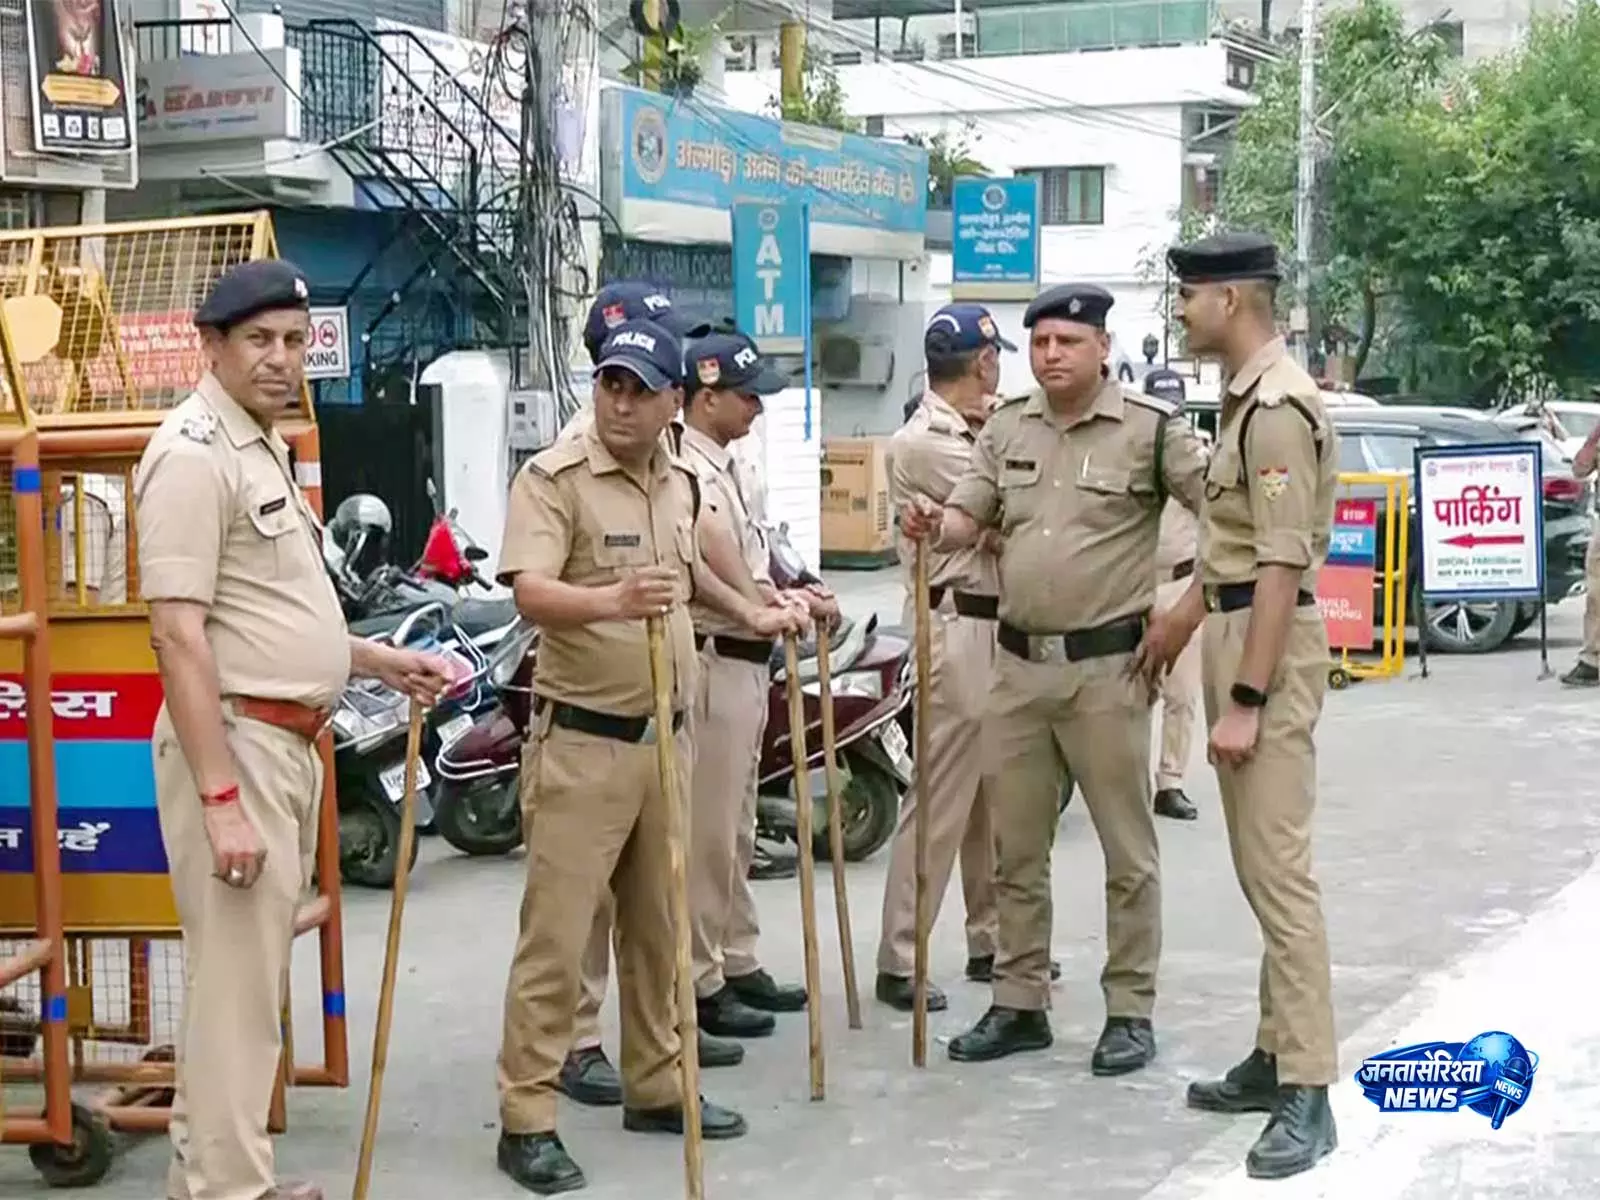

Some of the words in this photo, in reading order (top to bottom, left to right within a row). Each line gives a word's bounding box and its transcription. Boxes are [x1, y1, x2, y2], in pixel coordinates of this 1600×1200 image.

[755, 233, 784, 335] ATM
[612, 331, 656, 352] POLICE
[303, 350, 338, 366] KING
[1433, 485, 1521, 526] पार्किंग
